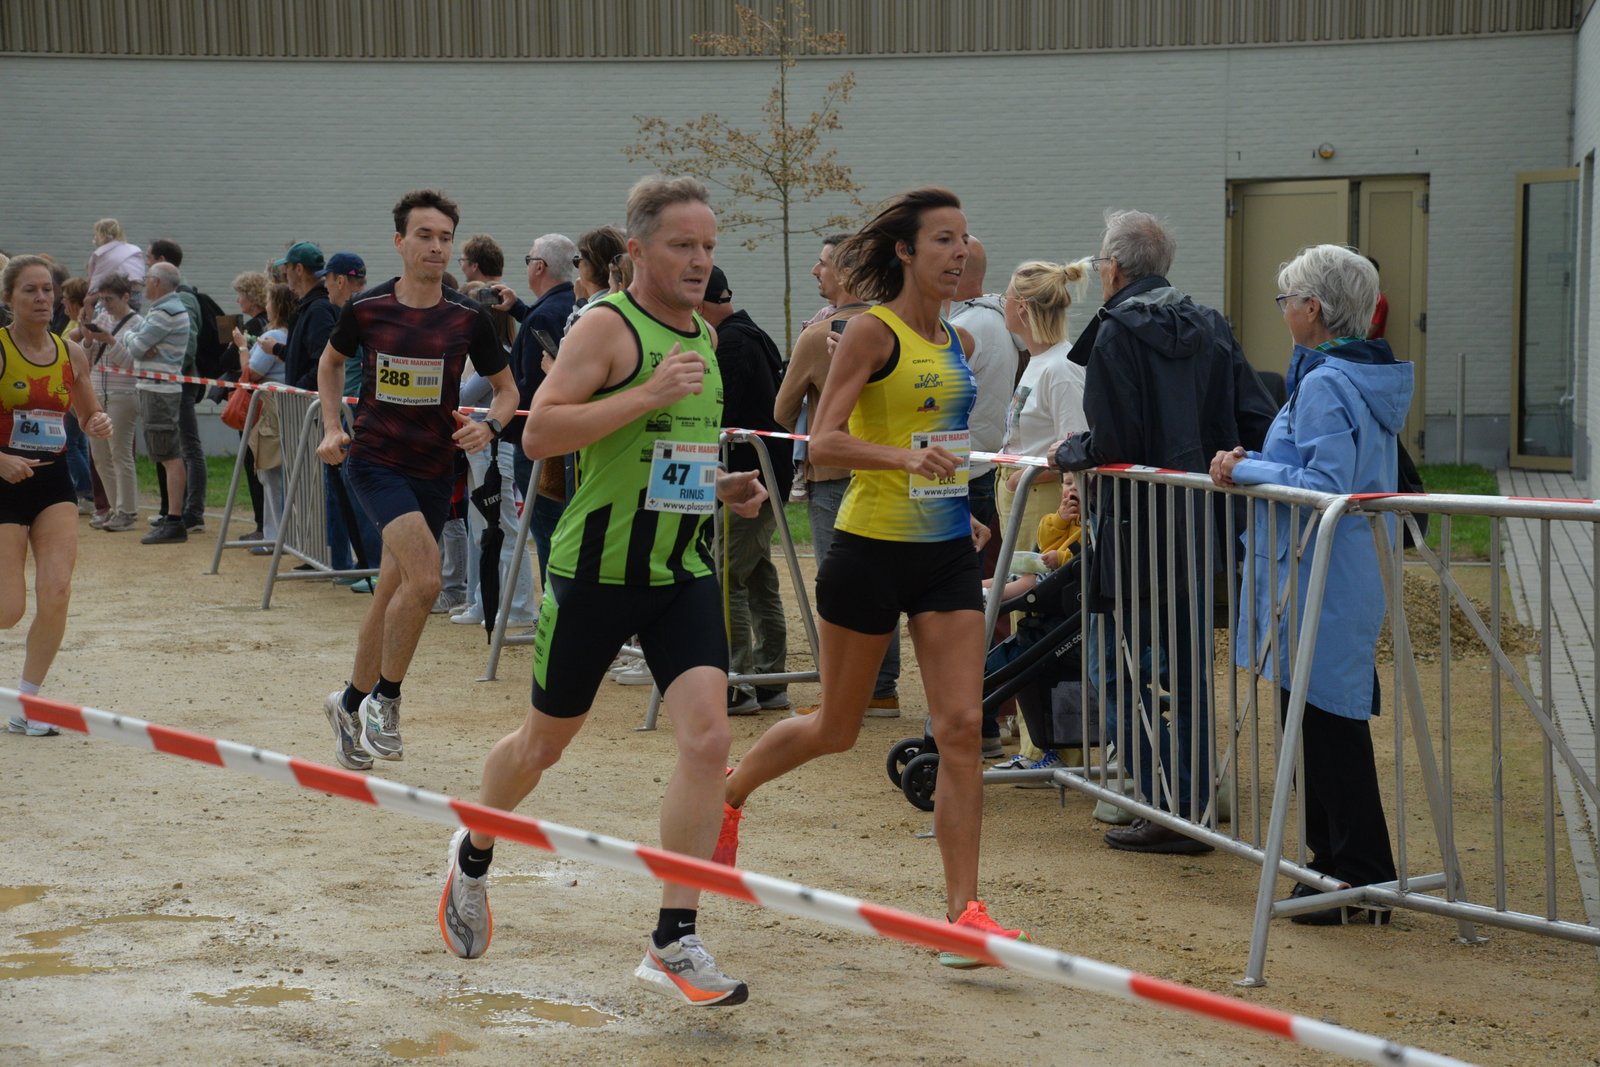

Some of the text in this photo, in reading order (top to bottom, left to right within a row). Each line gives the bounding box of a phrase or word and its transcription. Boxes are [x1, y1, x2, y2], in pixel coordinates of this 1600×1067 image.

[391, 357, 409, 366] HALVE
[380, 369, 410, 387] 288
[386, 396, 438, 404] www.plusprint.be
[20, 421, 40, 436] 64
[930, 434, 948, 442] HALVE
[676, 444, 697, 453] HALVE
[662, 463, 691, 485] 47
[680, 488, 705, 500] RINUS
